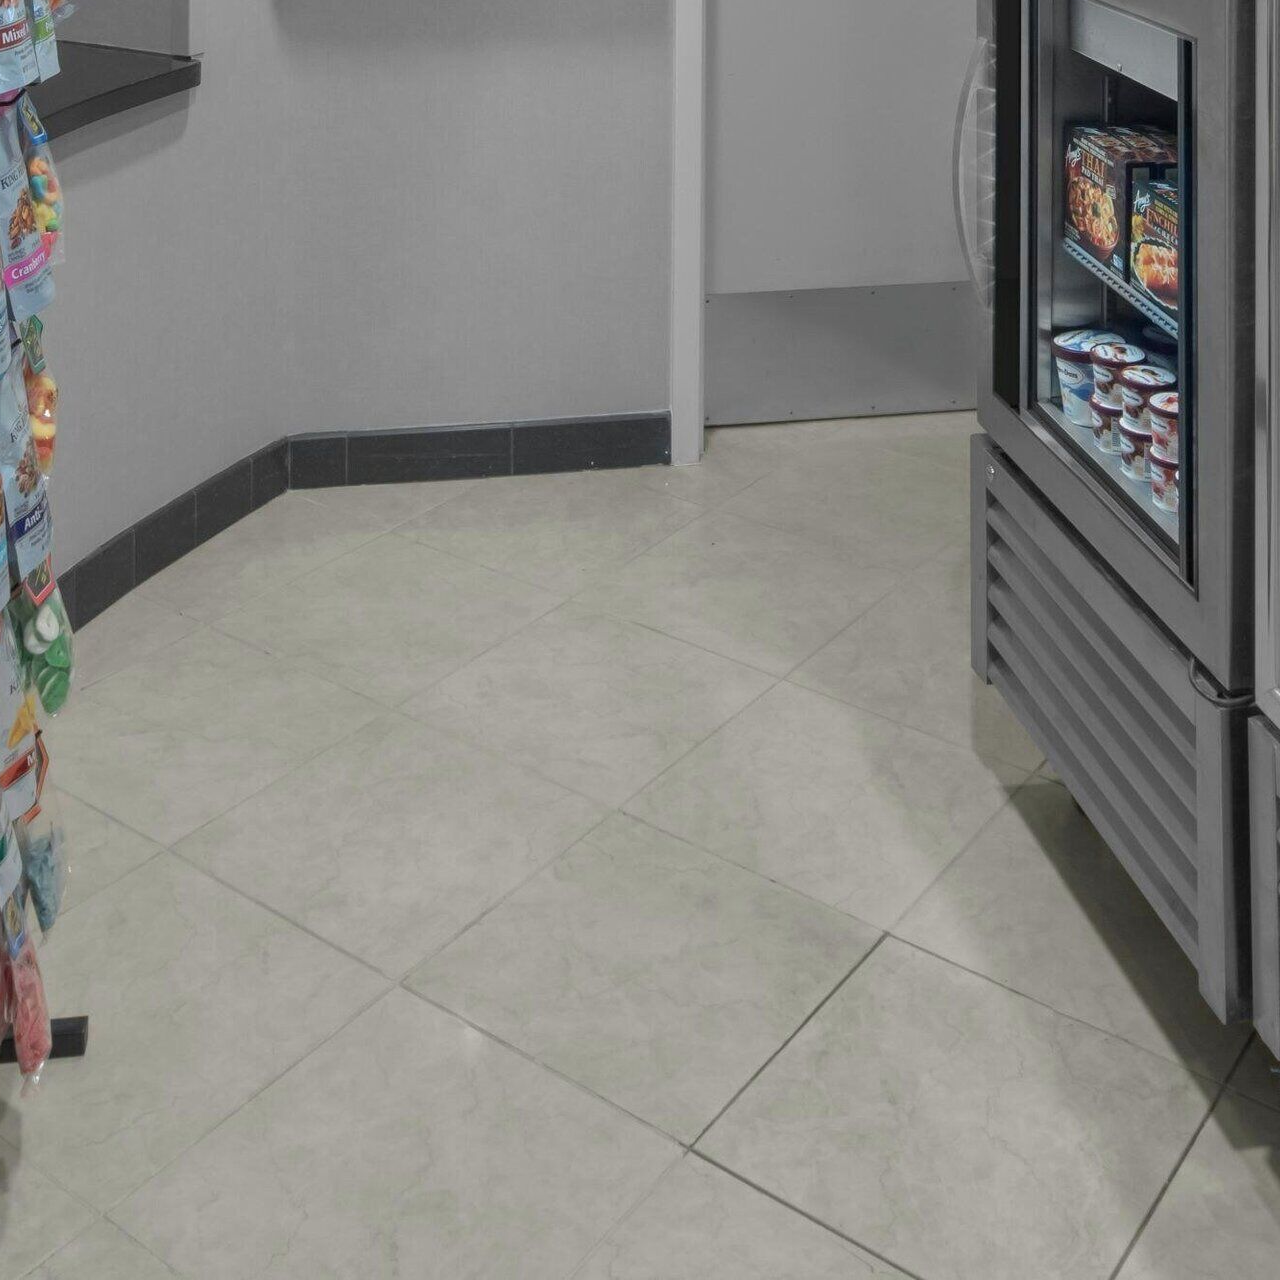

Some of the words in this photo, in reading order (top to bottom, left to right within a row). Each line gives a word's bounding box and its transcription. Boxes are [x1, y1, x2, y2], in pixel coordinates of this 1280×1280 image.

[1, 24, 27, 46] Mixed
[1081, 149, 1106, 178] THAI
[11, 250, 48, 282] Cranberry
